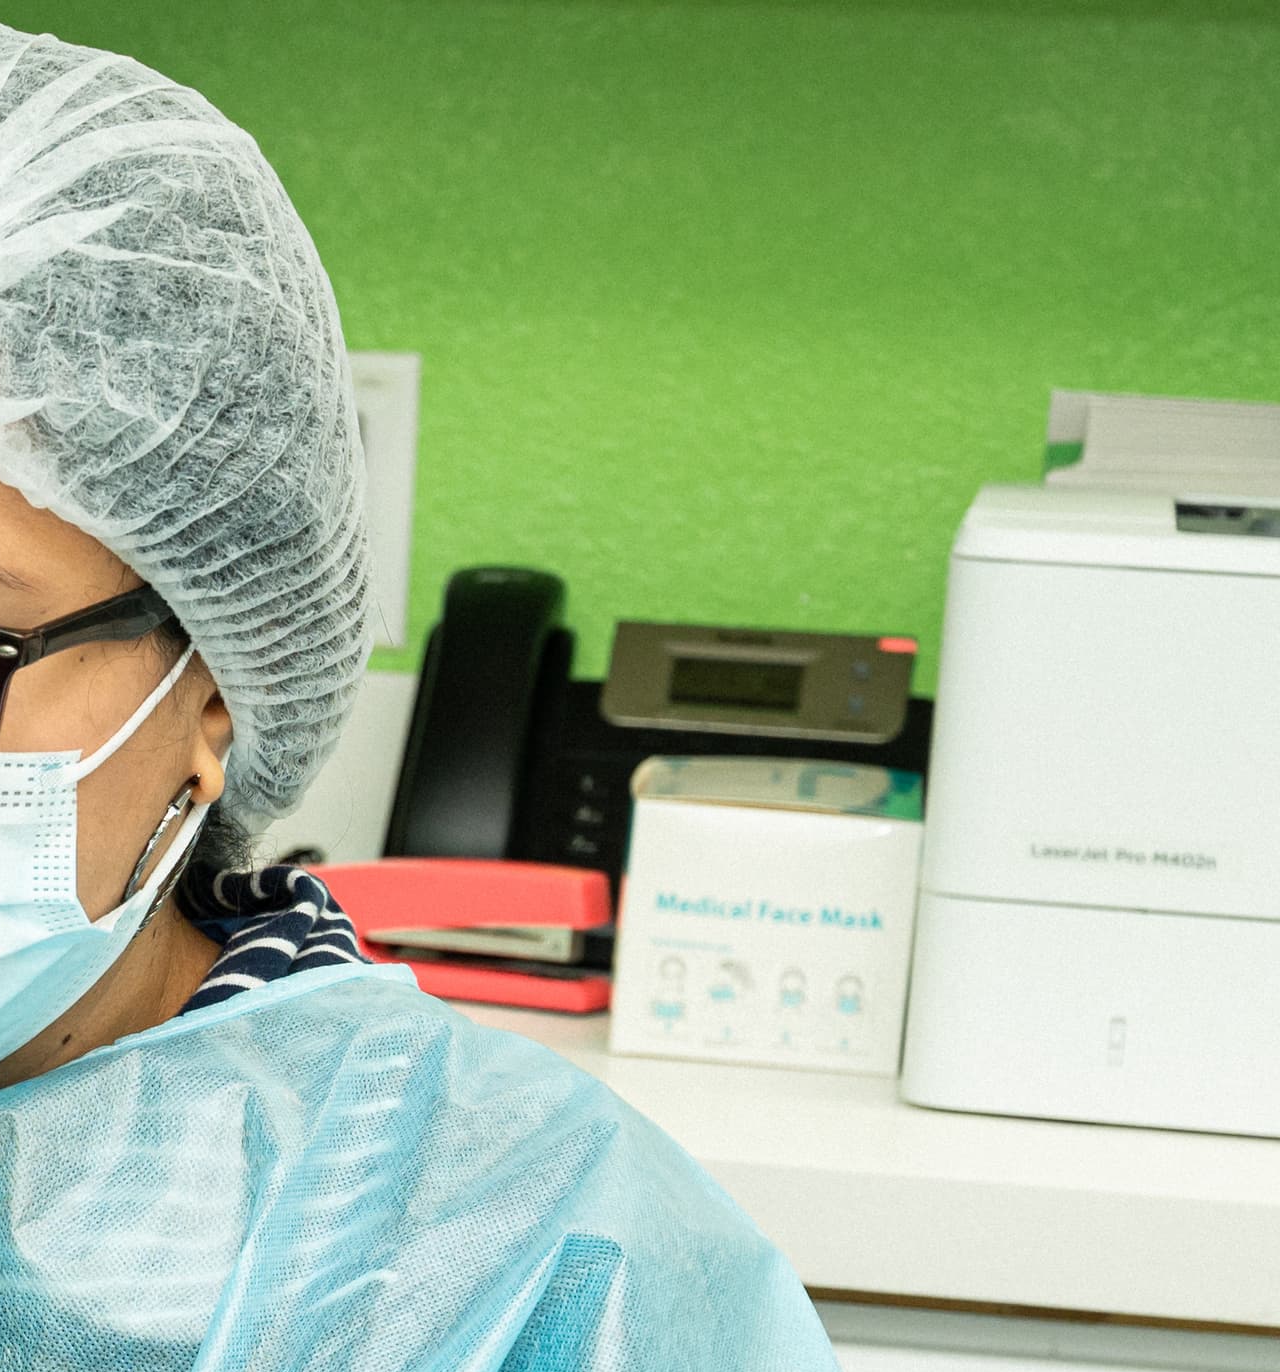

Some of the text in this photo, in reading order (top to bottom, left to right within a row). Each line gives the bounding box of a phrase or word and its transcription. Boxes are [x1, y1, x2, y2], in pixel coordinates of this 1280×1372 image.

[1030, 843, 1108, 863] LaserJet
[1115, 847, 1147, 864] Pro
[655, 893, 883, 930] Medical Face Mask
